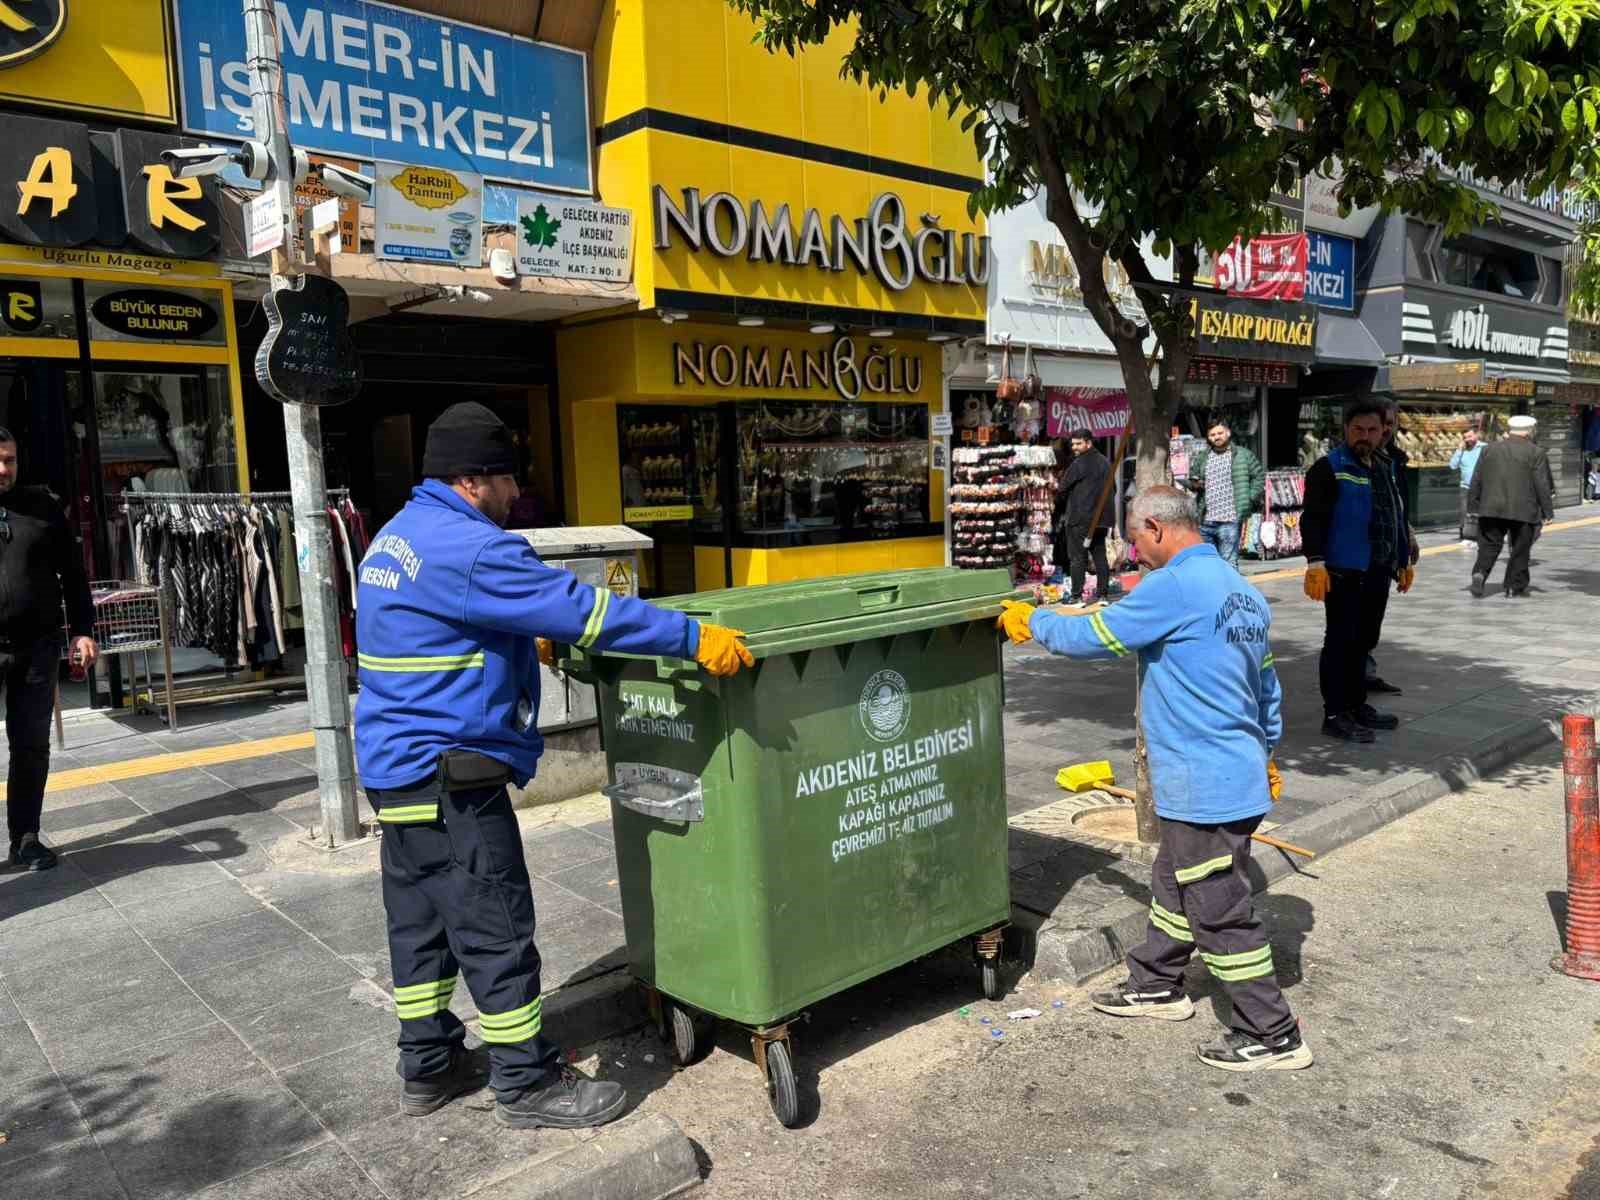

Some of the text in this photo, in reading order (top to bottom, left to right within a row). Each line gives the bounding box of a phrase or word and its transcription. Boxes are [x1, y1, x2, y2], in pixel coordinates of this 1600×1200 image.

[276, 5, 497, 97] MER-İN
[199, 43, 555, 170] İŞ MERKEZİ
[579, 226, 613, 242] AKDENİZ
[107, 252, 174, 271] Mağaza
[562, 239, 581, 258] İLÇE
[520, 256, 560, 268] GELECEK
[110, 298, 203, 318] BÜYÜK BEDEN
[127, 316, 189, 332] BULUNUR
[1200, 307, 1256, 344] EŞARP
[1254, 314, 1314, 346] DURAĞI
[361, 565, 401, 591] MERSİN
[648, 695, 679, 717] KALA
[795, 719, 974, 799] AKDENİZ BELEDİYESİ
[845, 763, 939, 808] ATEŞ ATMAYINIZ
[839, 783, 945, 833] KAPAĞI KAPATINIZ
[831, 821, 887, 863] ÇEVREMİZİ
